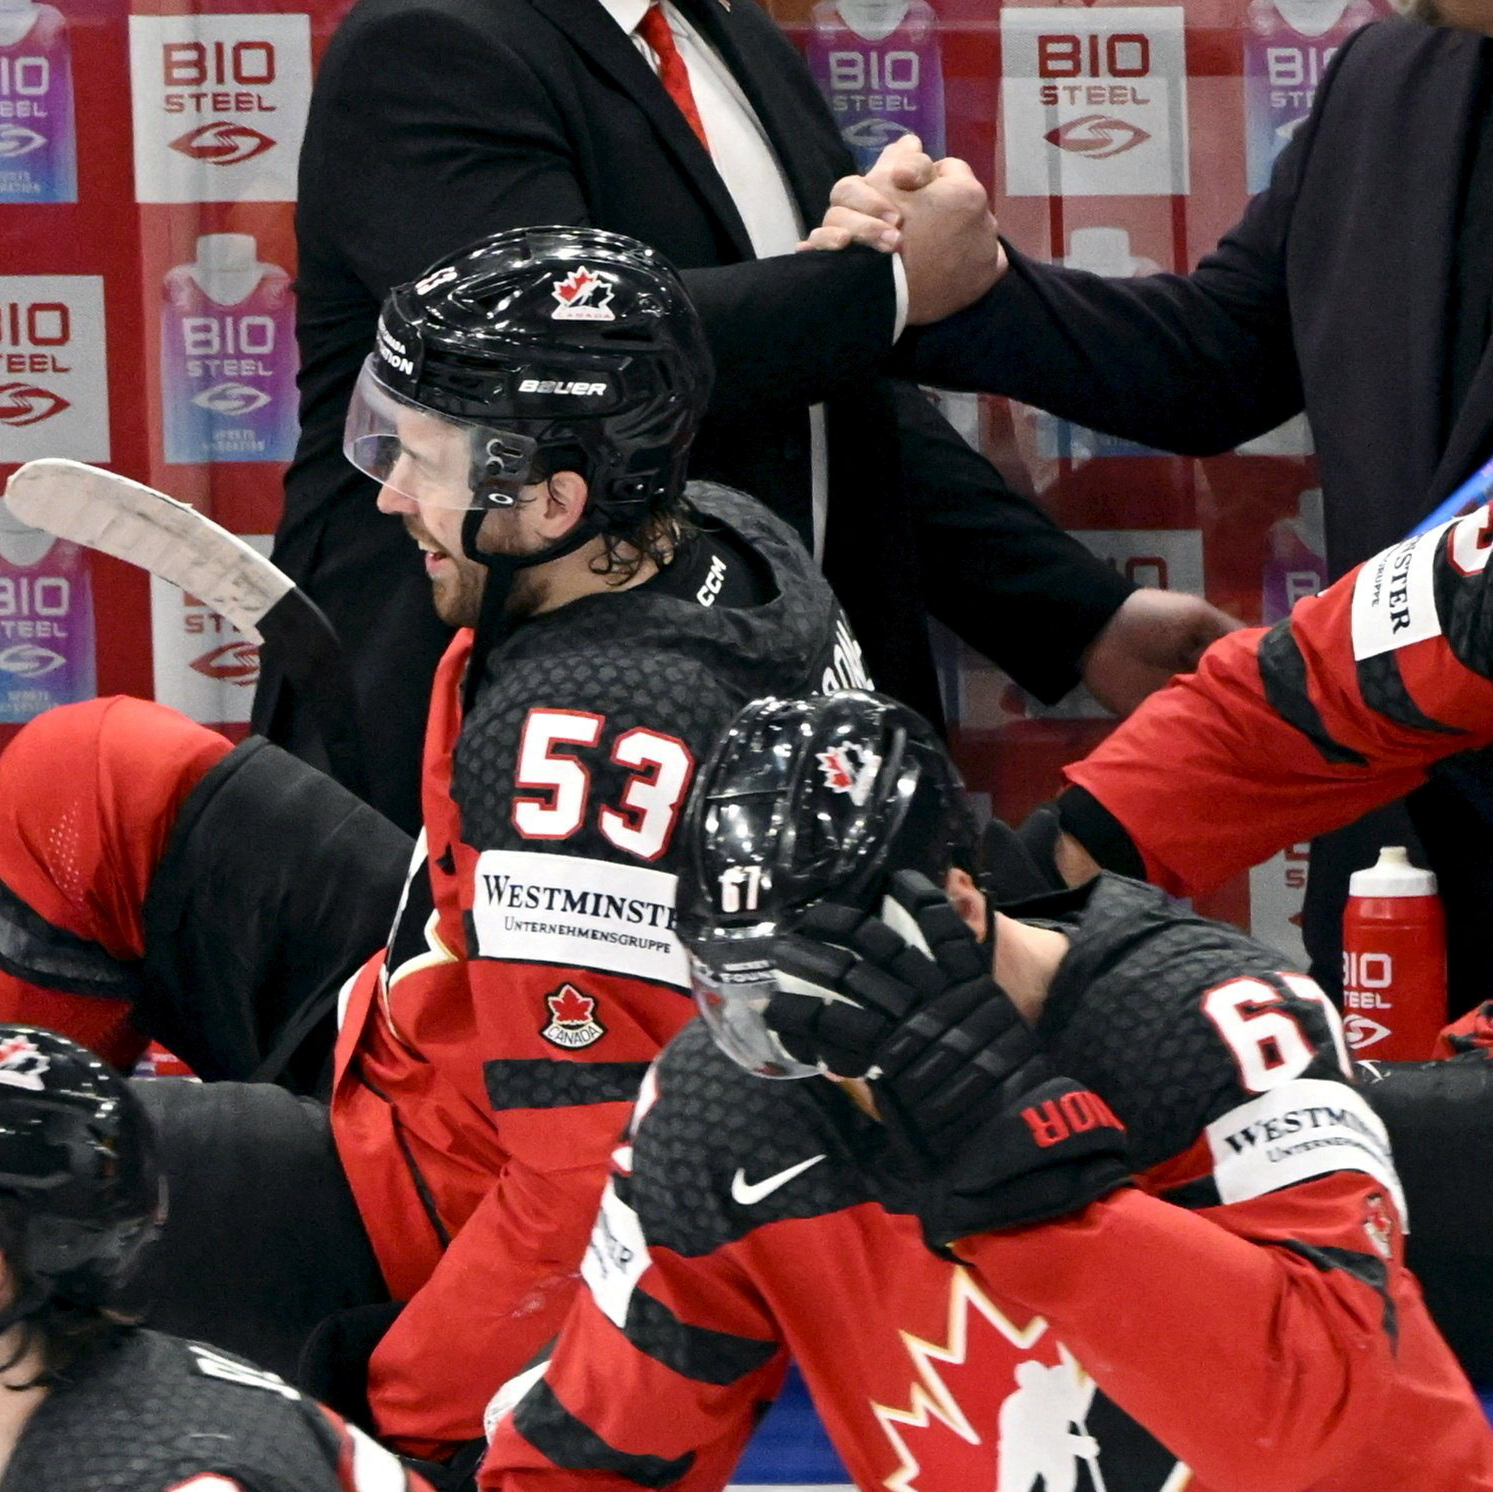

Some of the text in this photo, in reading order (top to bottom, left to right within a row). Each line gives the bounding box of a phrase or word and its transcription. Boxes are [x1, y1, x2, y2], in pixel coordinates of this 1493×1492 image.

[163, 41, 275, 86] BIO
[829, 51, 920, 90] BIO
[1038, 34, 1150, 78] BIO
[164, 92, 277, 114] STEEL
[832, 95, 917, 112] STEEL
[1038, 86, 1150, 106] STEEL
[183, 315, 273, 356] BIO
[186, 360, 273, 378] STEEL
[518, 379, 607, 396] BAUER
[696, 555, 727, 608] CCM
[513, 707, 695, 863] 53
[504, 915, 672, 954] UNTERNEHMENSGRUPPE
[547, 1024, 600, 1046] CANADA
[1201, 971, 1357, 1097] 67
